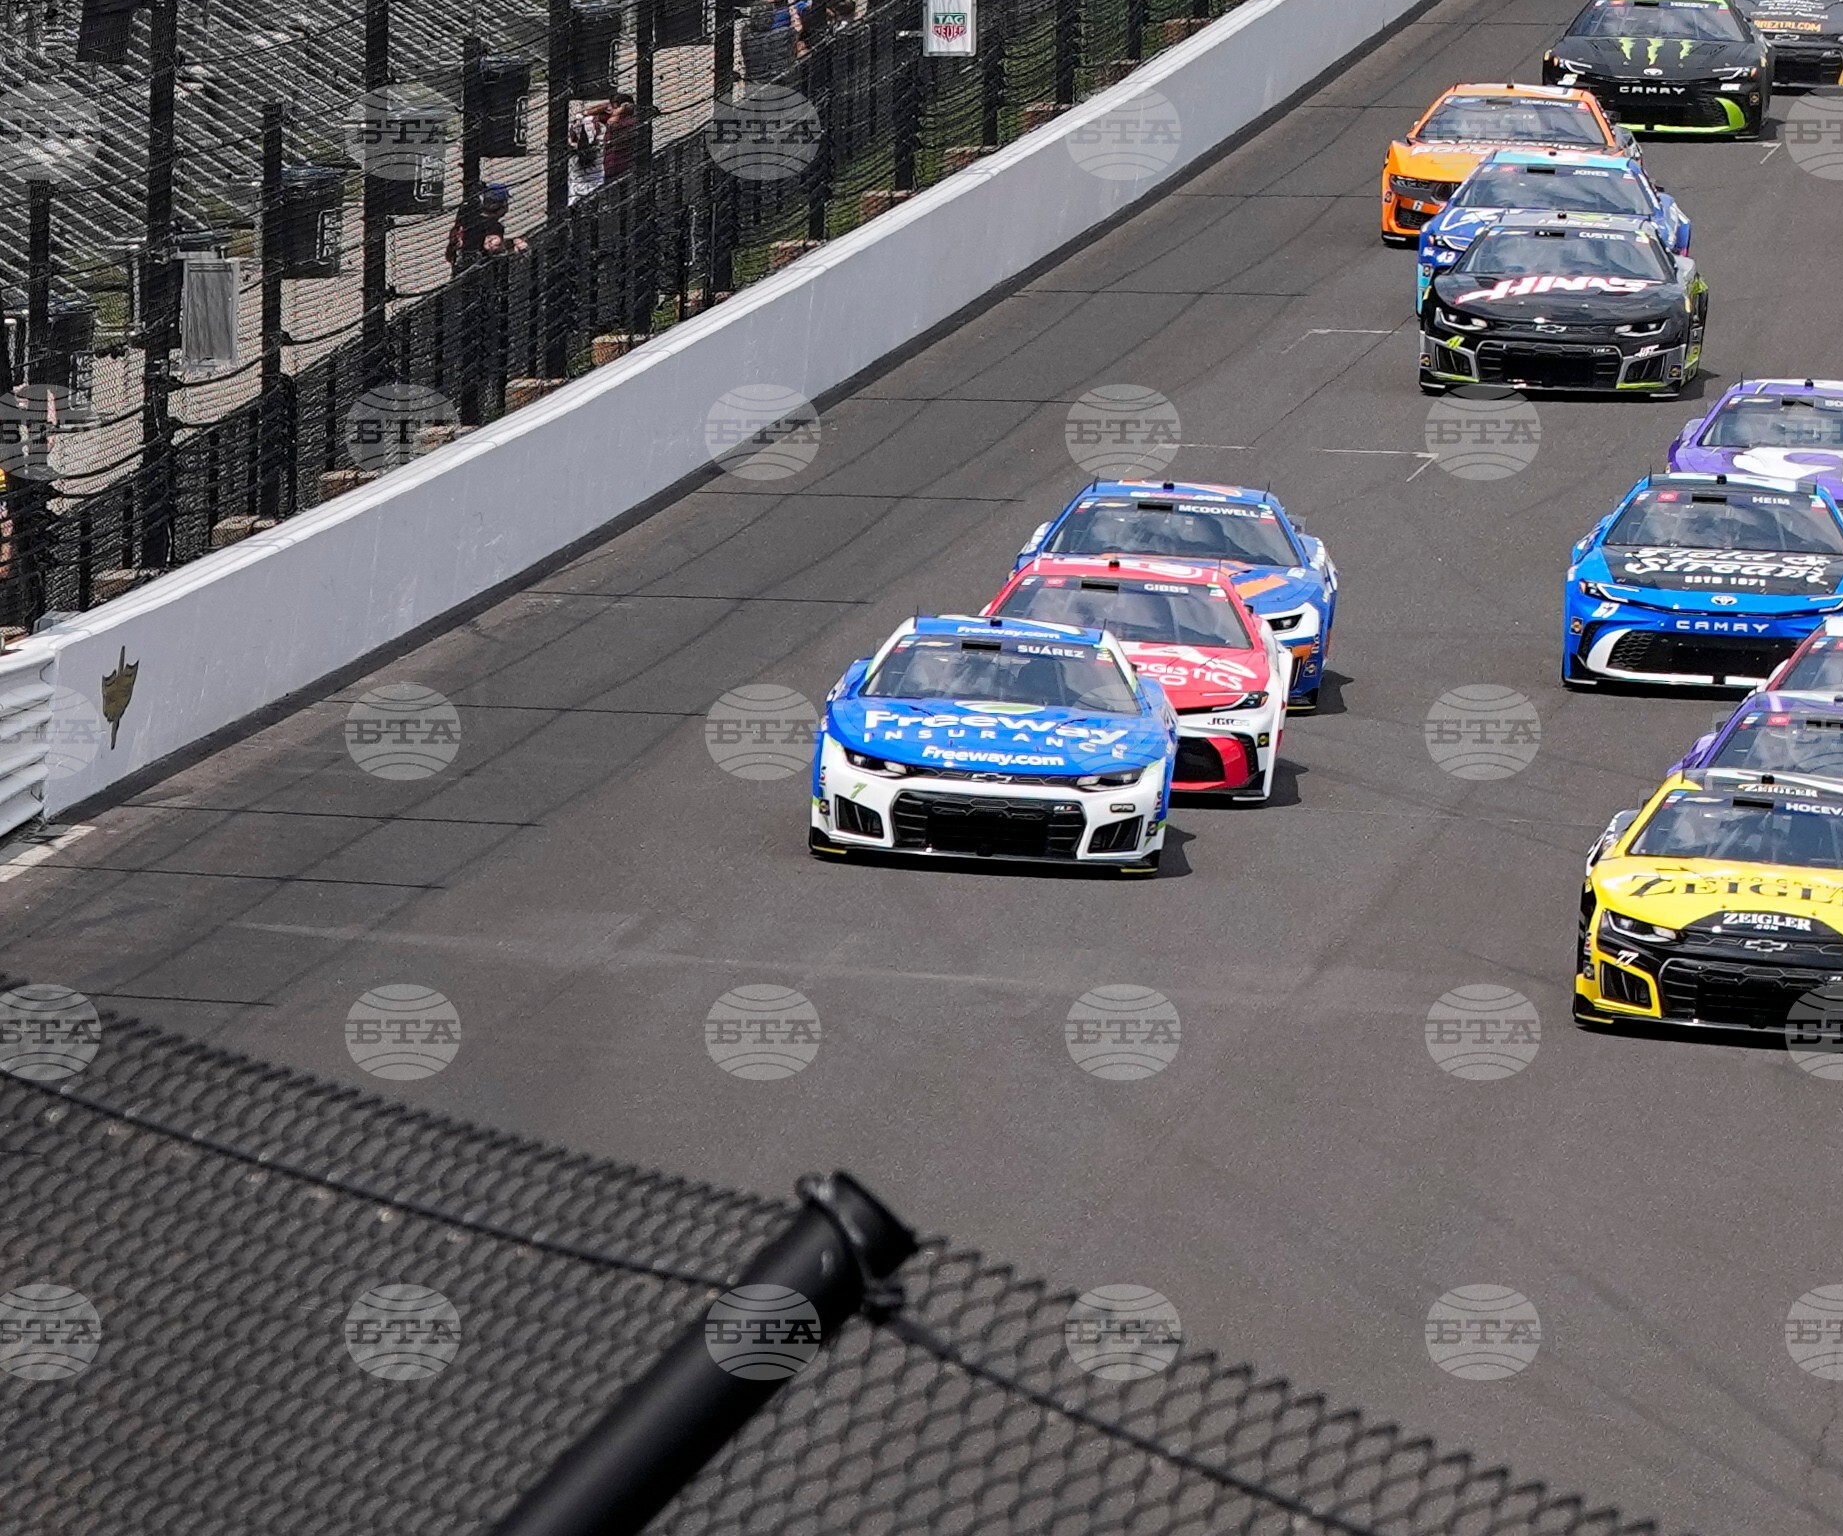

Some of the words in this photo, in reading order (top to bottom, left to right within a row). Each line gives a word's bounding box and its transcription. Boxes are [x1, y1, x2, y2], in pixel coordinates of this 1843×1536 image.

[936, 15, 965, 25] TAG
[1619, 85, 1687, 94] CAMRY
[1573, 169, 1610, 177] JONES
[1578, 231, 1626, 242] CUSTER
[1436, 251, 1455, 264] 43
[1751, 495, 1791, 506] HEIM
[1178, 503, 1260, 519] MCDOWELL
[1143, 582, 1190, 595] GIBBS
[956, 625, 1060, 639] Freeway.com
[1676, 619, 1769, 632] CAMRY
[1017, 643, 1085, 659] SUÁREZ
[1135, 664, 1243, 691] OGISTICS
[864, 710, 1129, 745] Freeway
[864, 729, 1129, 760] INSURANCE
[921, 745, 1065, 766] Freeway.com
[849, 782, 869, 799] 7
[1722, 912, 1812, 932] ZEIGLER
[1613, 949, 1639, 966] 77
